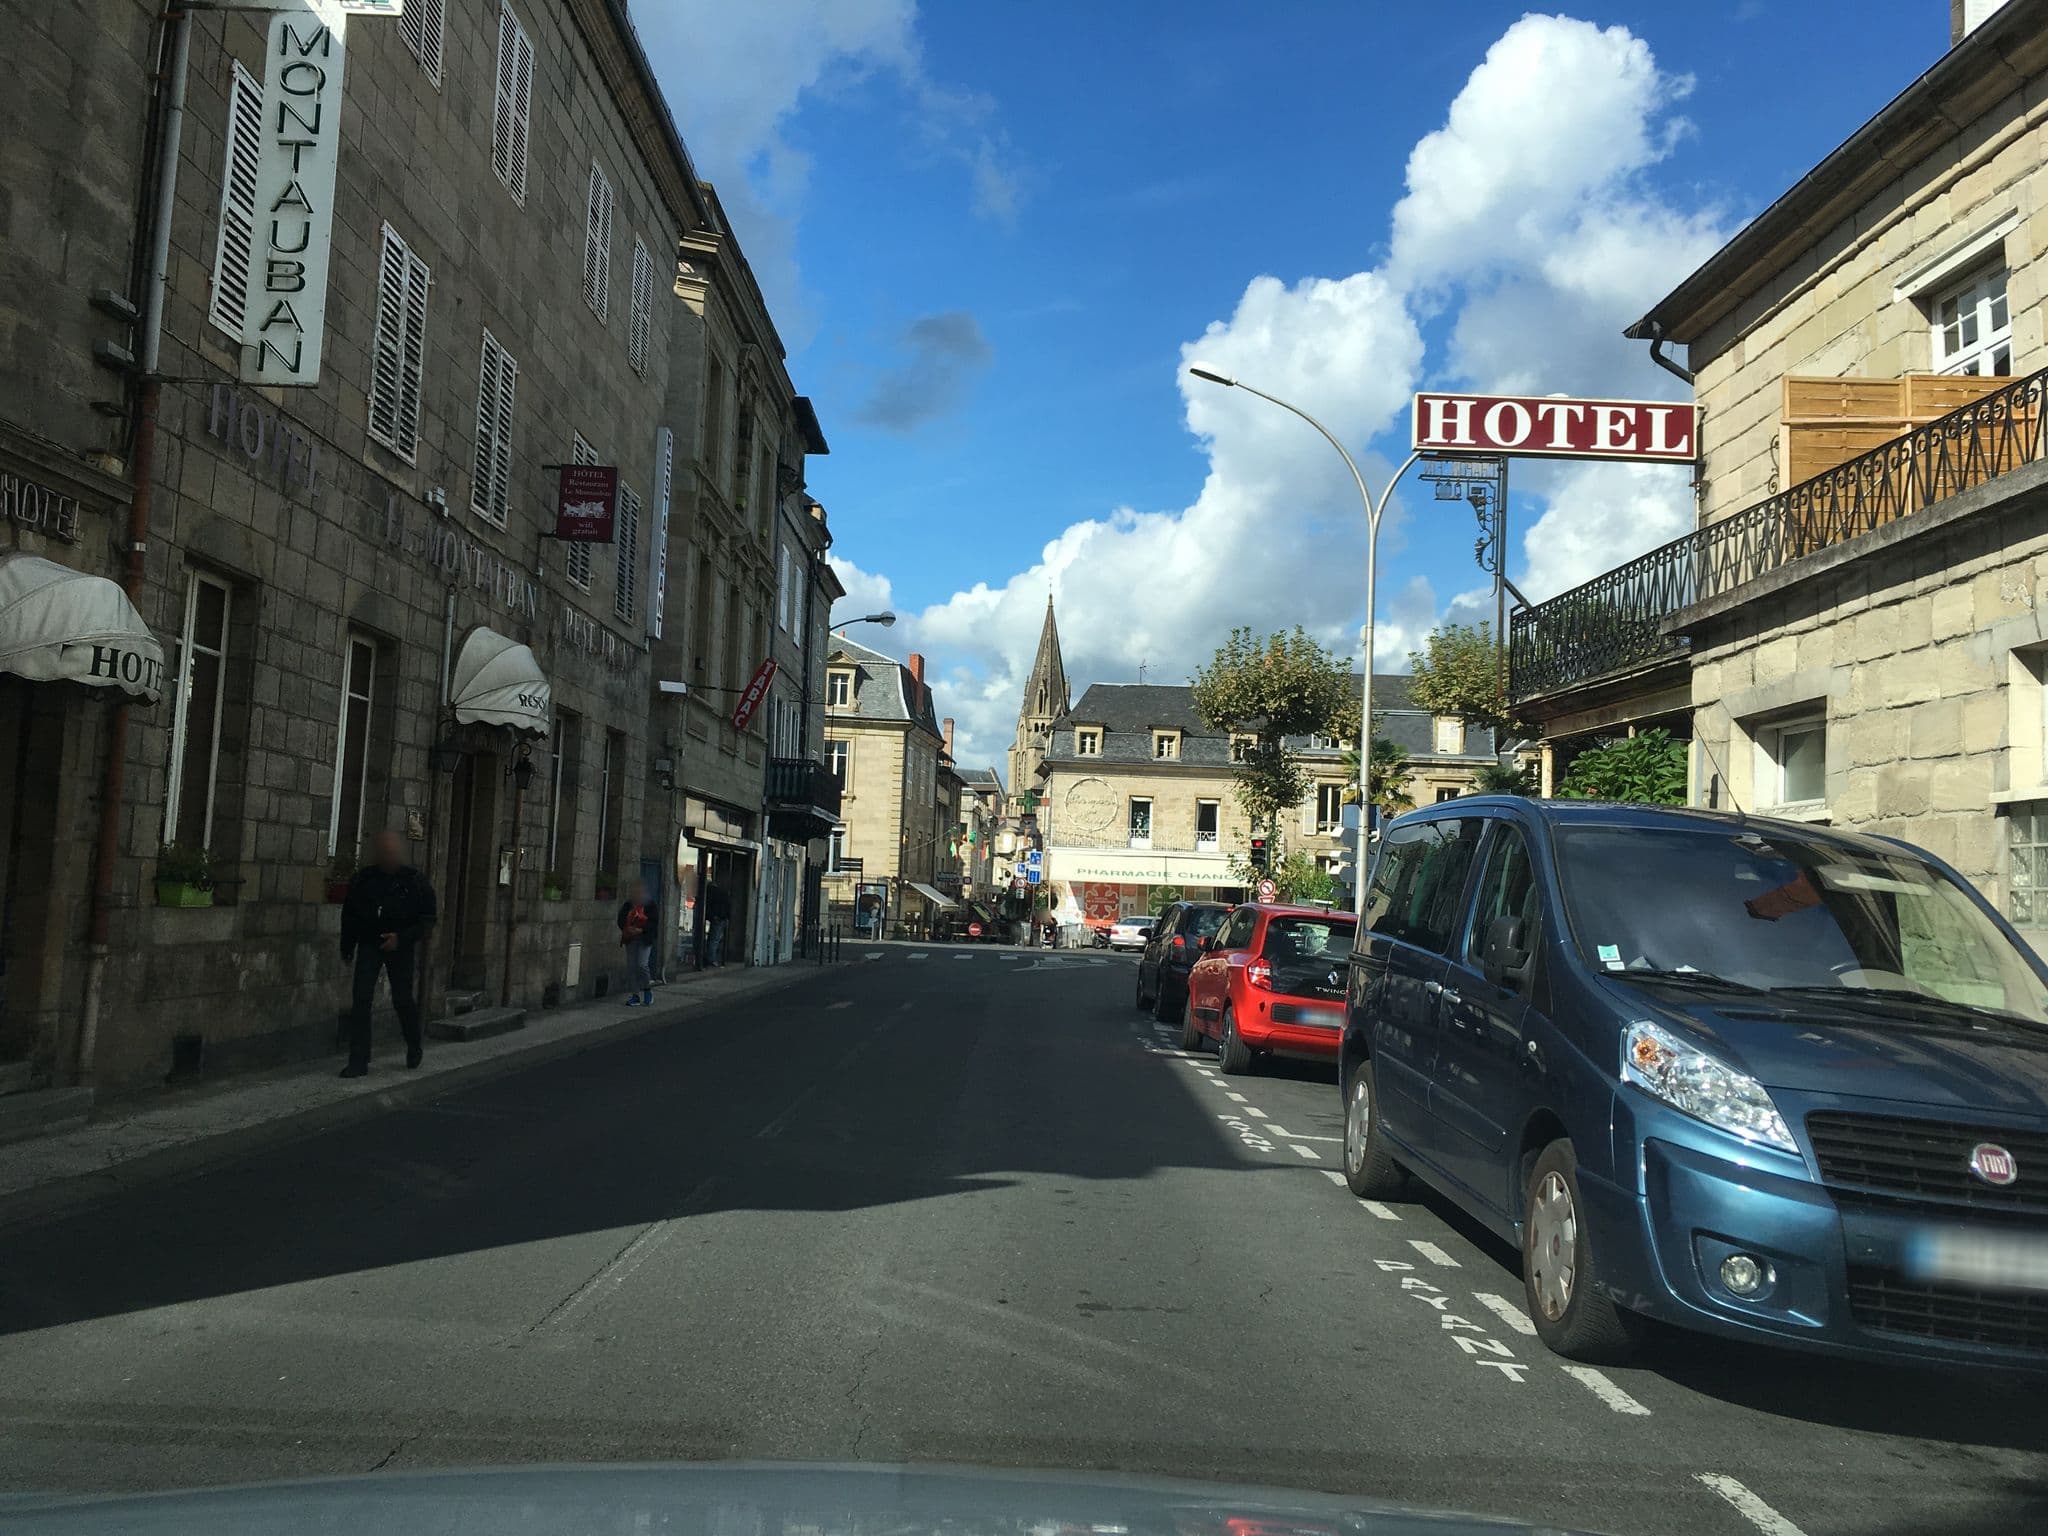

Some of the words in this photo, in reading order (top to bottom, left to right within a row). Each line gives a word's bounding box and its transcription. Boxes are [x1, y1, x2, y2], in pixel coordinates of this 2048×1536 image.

[258, 21, 331, 374] MONTAUBAN
[1423, 398, 1689, 454] HOTEL
[735, 662, 774, 727] TABAC
[1077, 868, 1172, 879] PHARMACIE
[1373, 1259, 1529, 1383] PAYANT
